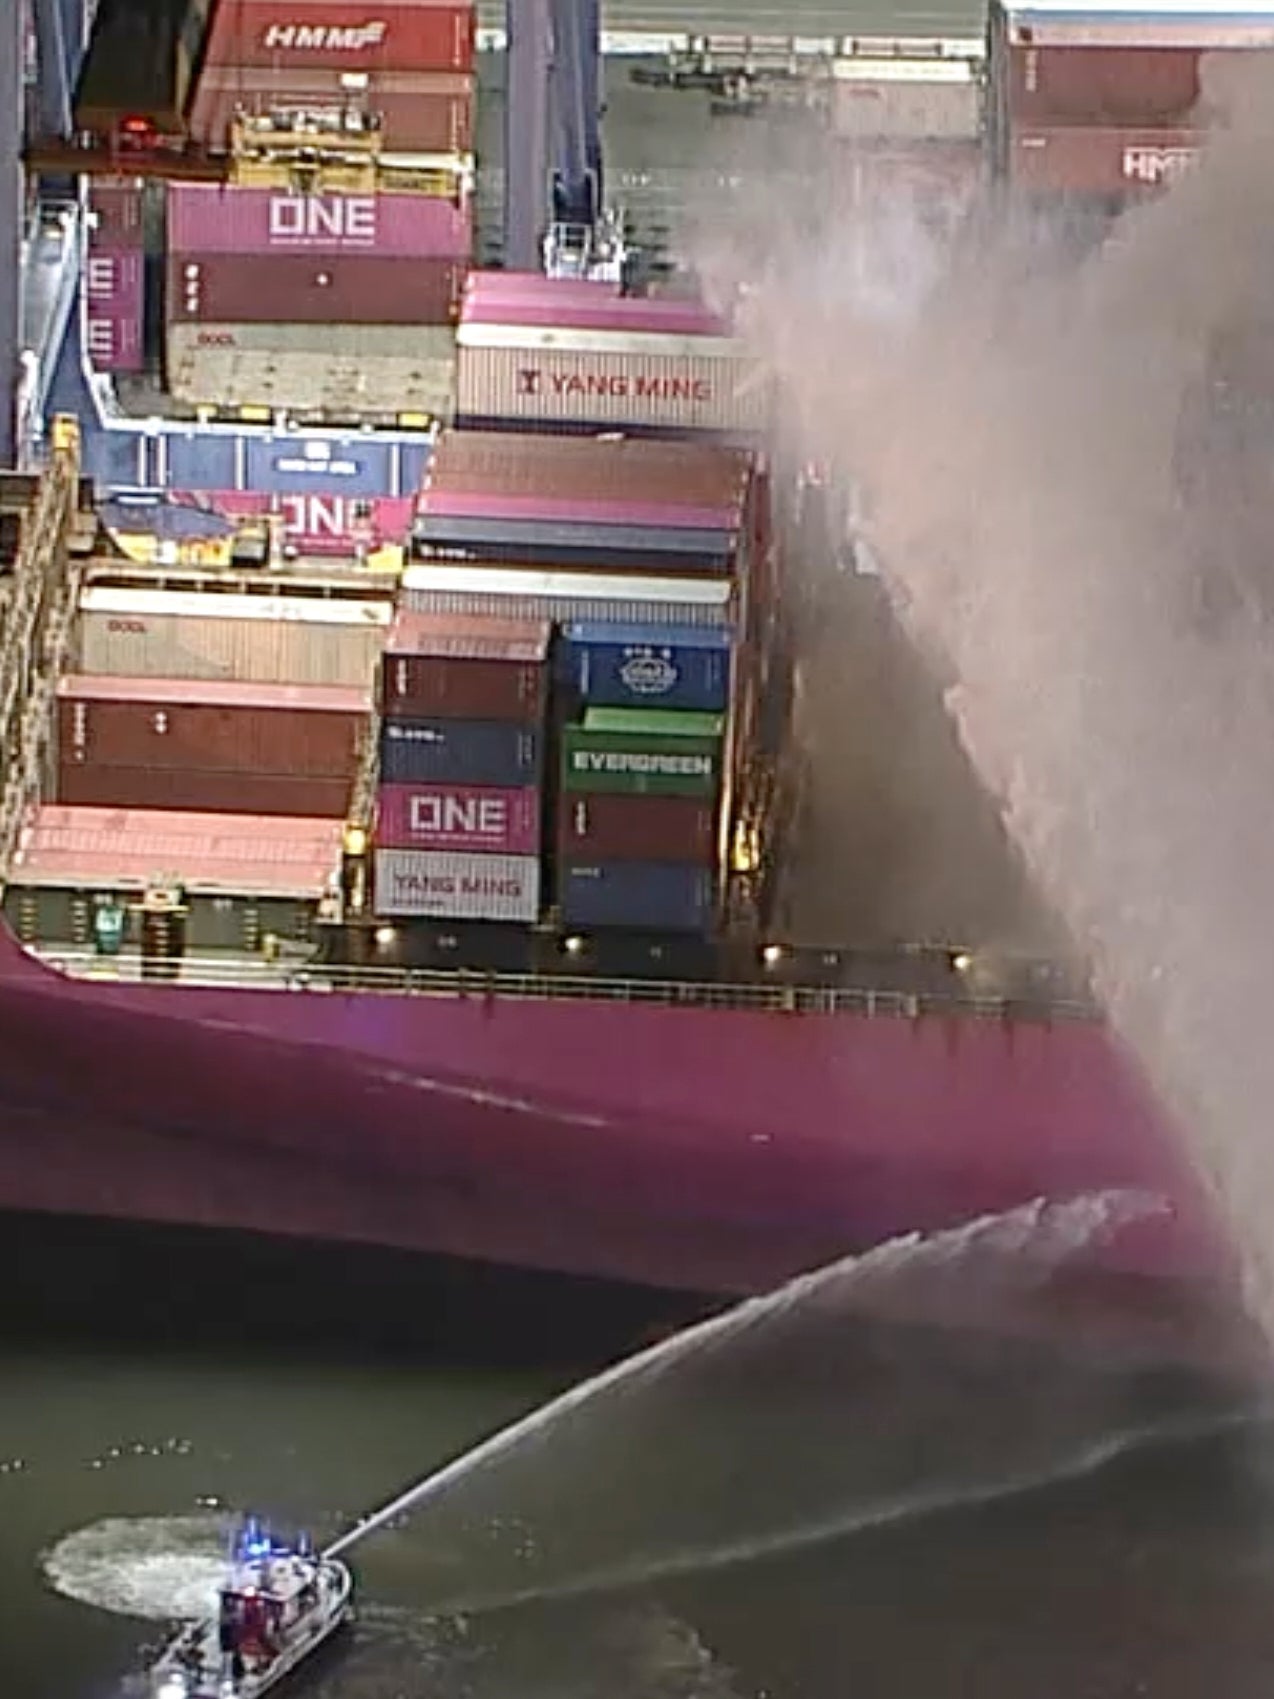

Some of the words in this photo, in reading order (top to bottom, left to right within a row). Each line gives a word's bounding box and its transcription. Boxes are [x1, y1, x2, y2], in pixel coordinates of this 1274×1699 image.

[265, 23, 374, 48] HMM
[269, 196, 375, 236] ONE
[551, 374, 628, 396] YANG
[636, 377, 712, 401] MING
[574, 752, 712, 775] EVERGREEN
[410, 796, 506, 832] ONE
[394, 874, 455, 893] YANG
[461, 876, 523, 898] MING
